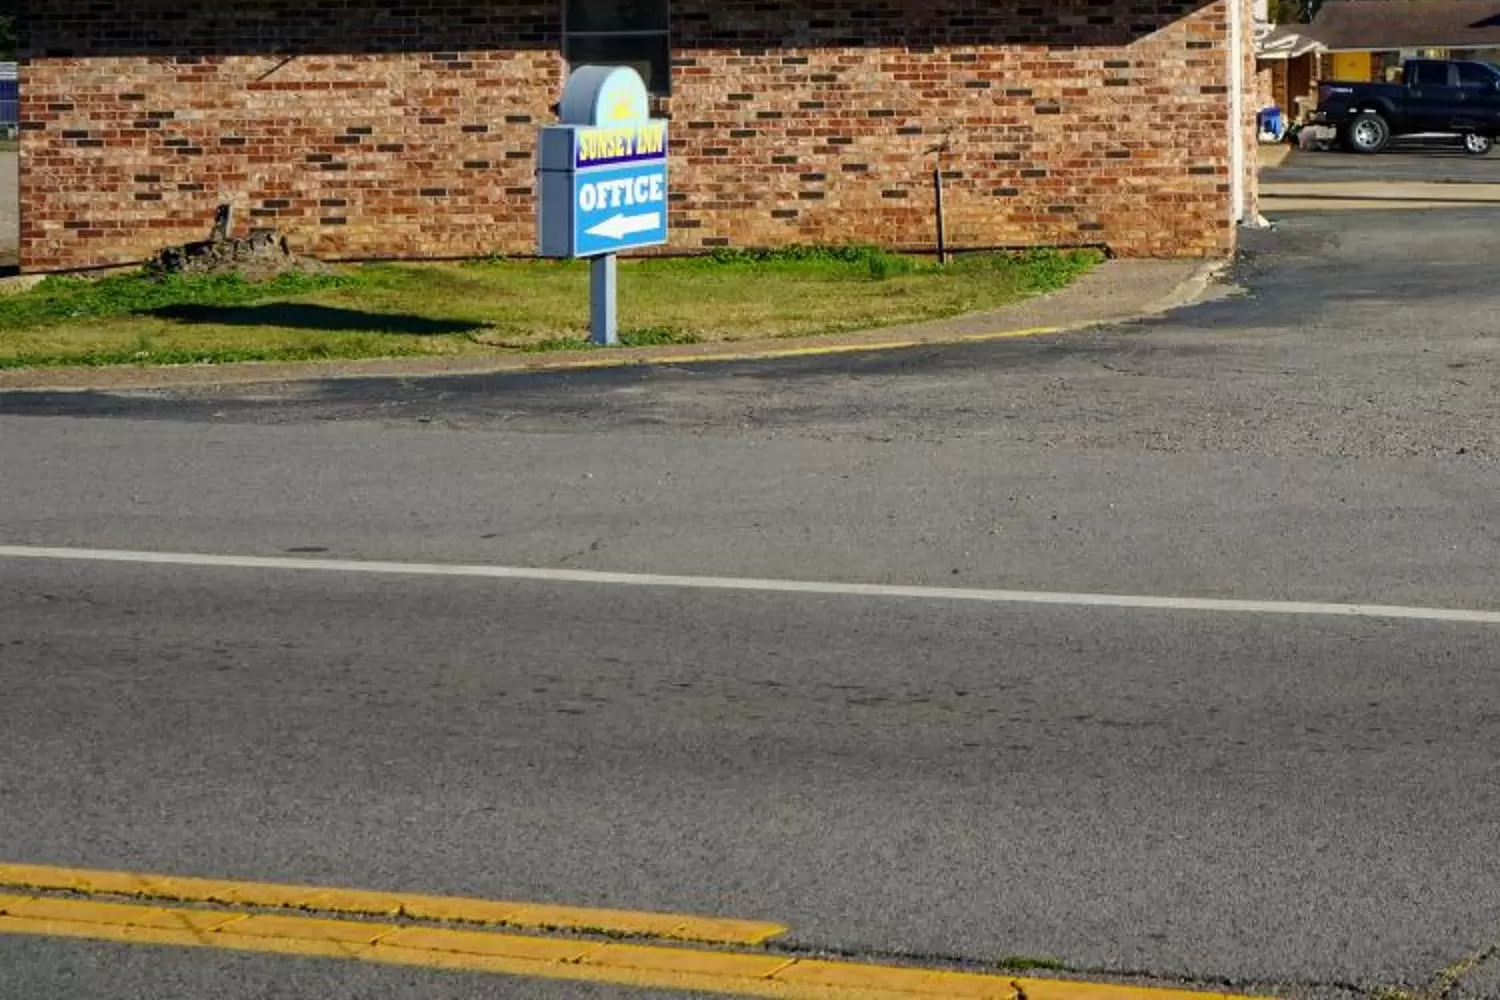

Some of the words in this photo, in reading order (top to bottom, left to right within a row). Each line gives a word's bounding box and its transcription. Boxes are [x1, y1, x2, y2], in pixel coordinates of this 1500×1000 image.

[579, 128, 634, 161] SUNSET
[636, 124, 664, 154] INN
[579, 173, 664, 213] OFFICE
